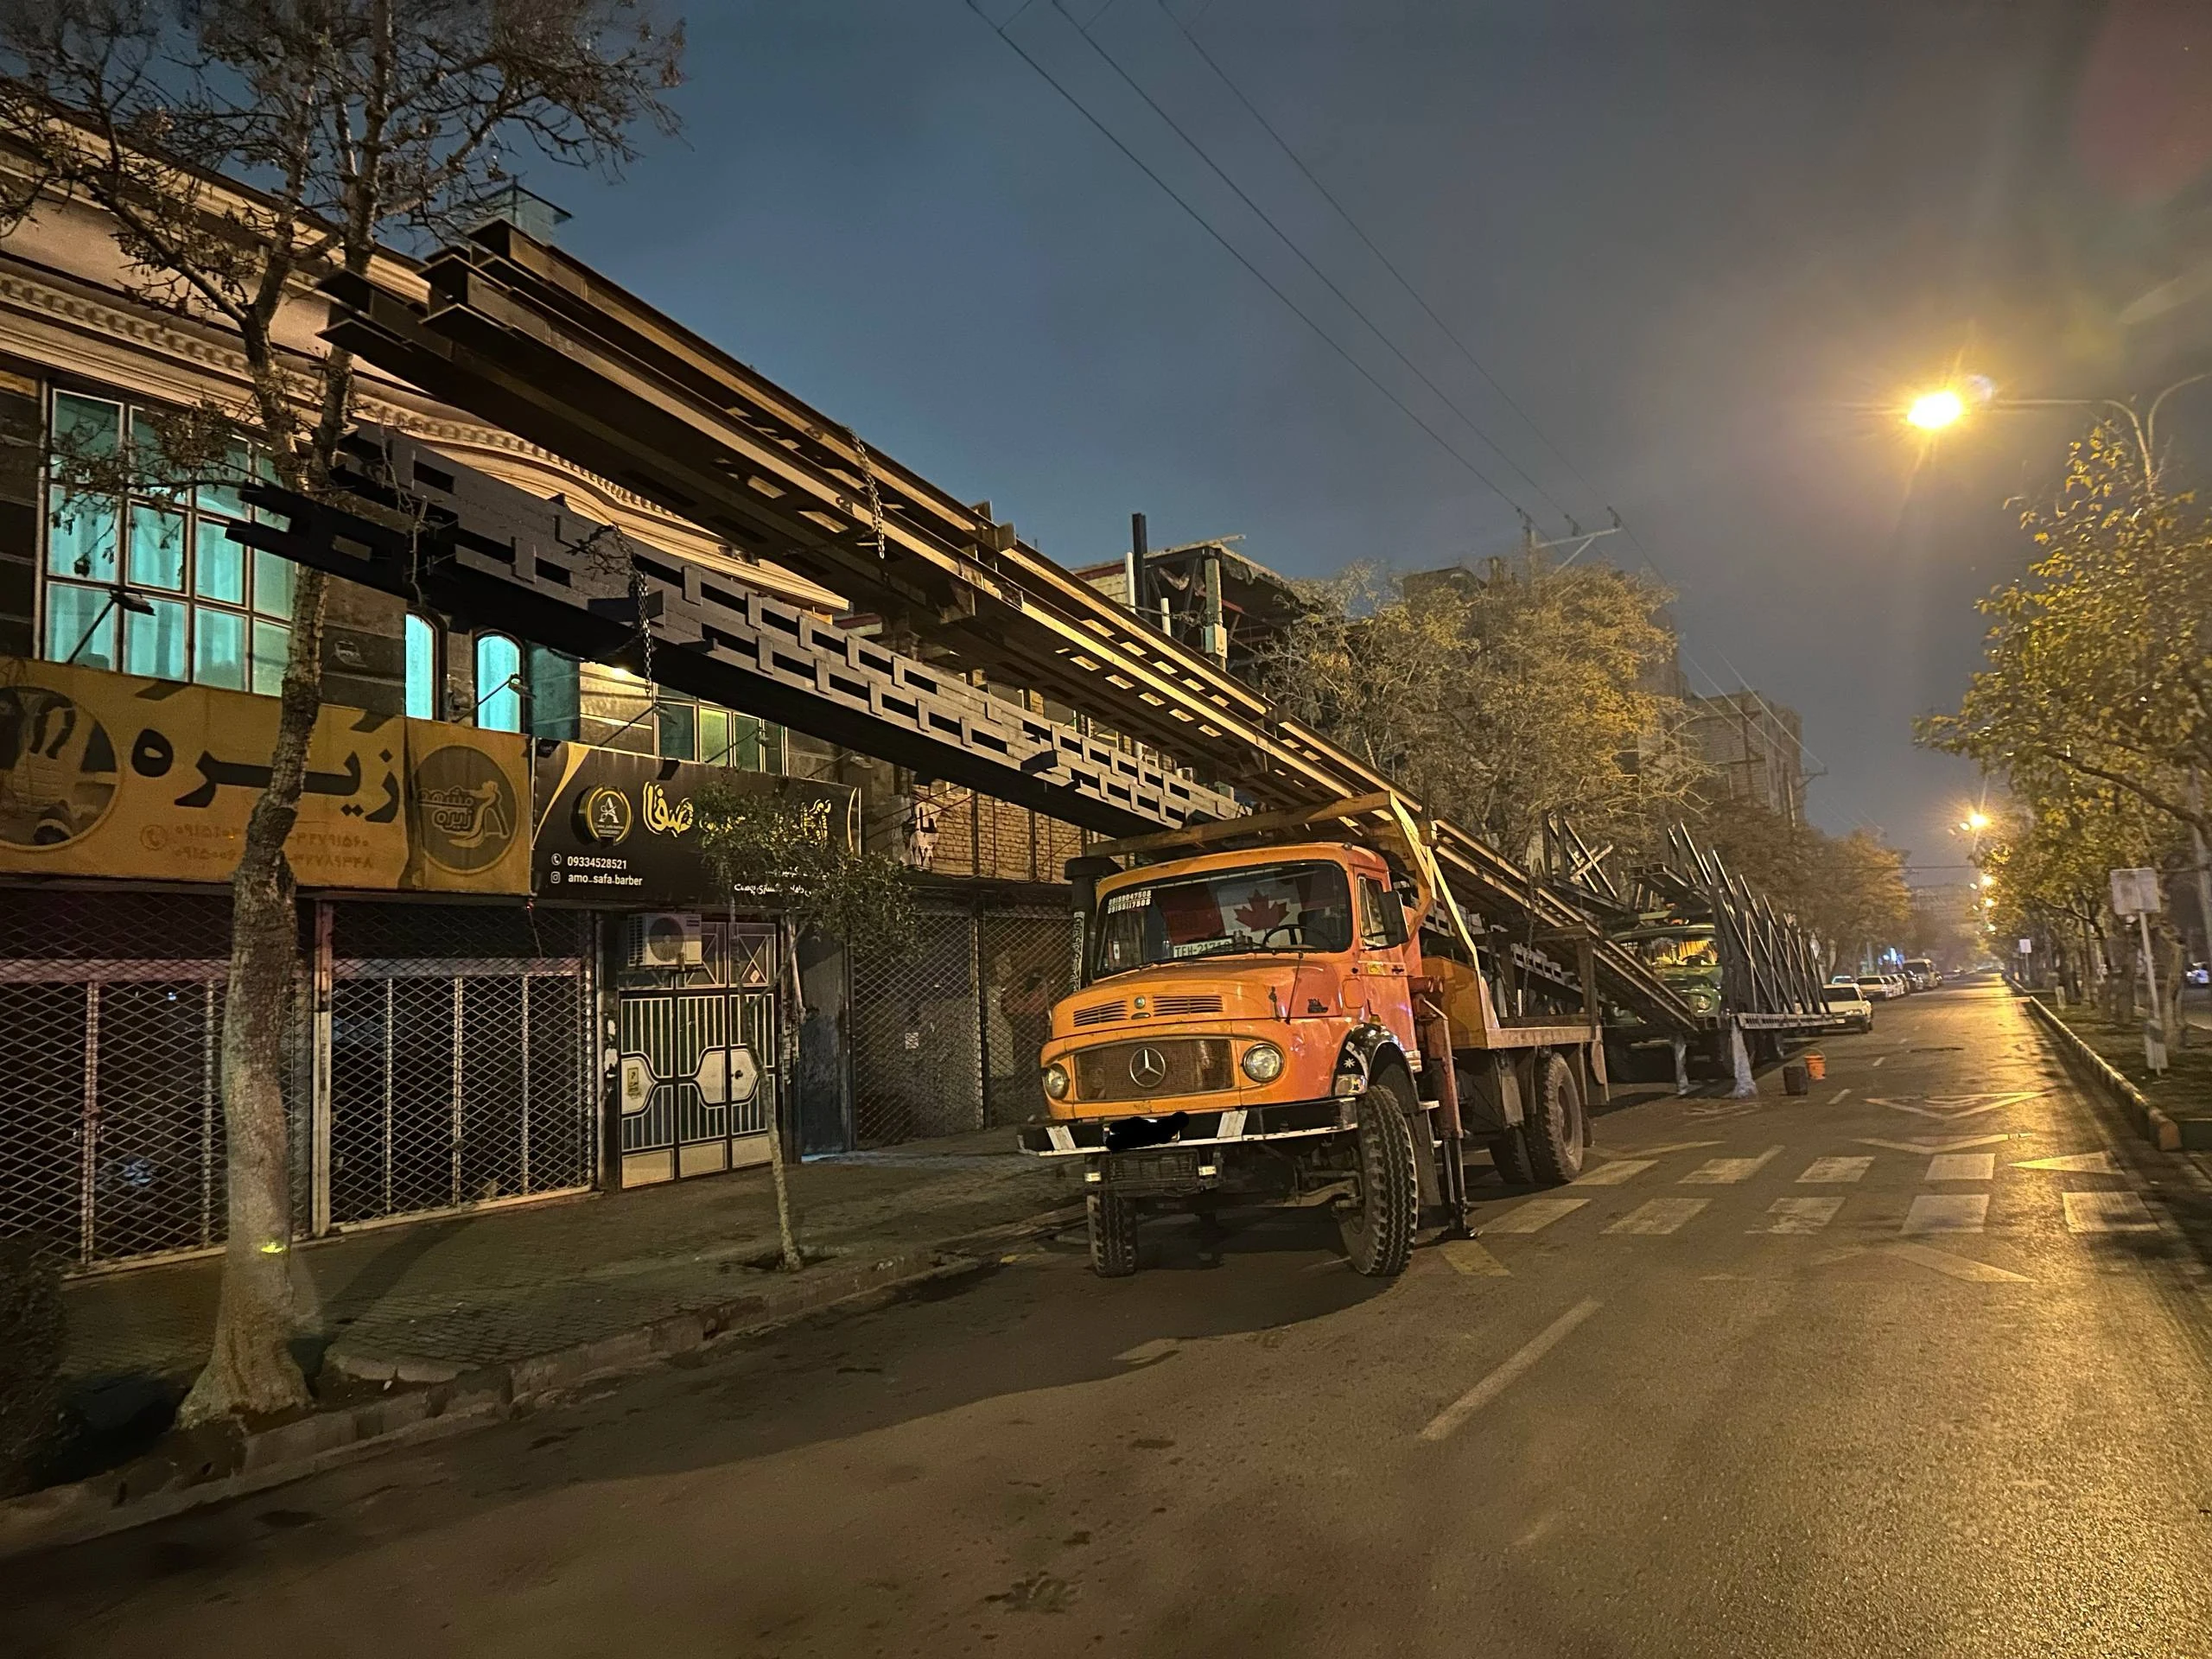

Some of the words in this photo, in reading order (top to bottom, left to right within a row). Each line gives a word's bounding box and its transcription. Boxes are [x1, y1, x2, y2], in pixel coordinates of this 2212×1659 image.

[130, 728, 401, 823] زیره
[643, 781, 694, 838] صفا
[567, 856, 627, 870] 09334528521
[568, 873, 643, 887] amo_safa.barber
